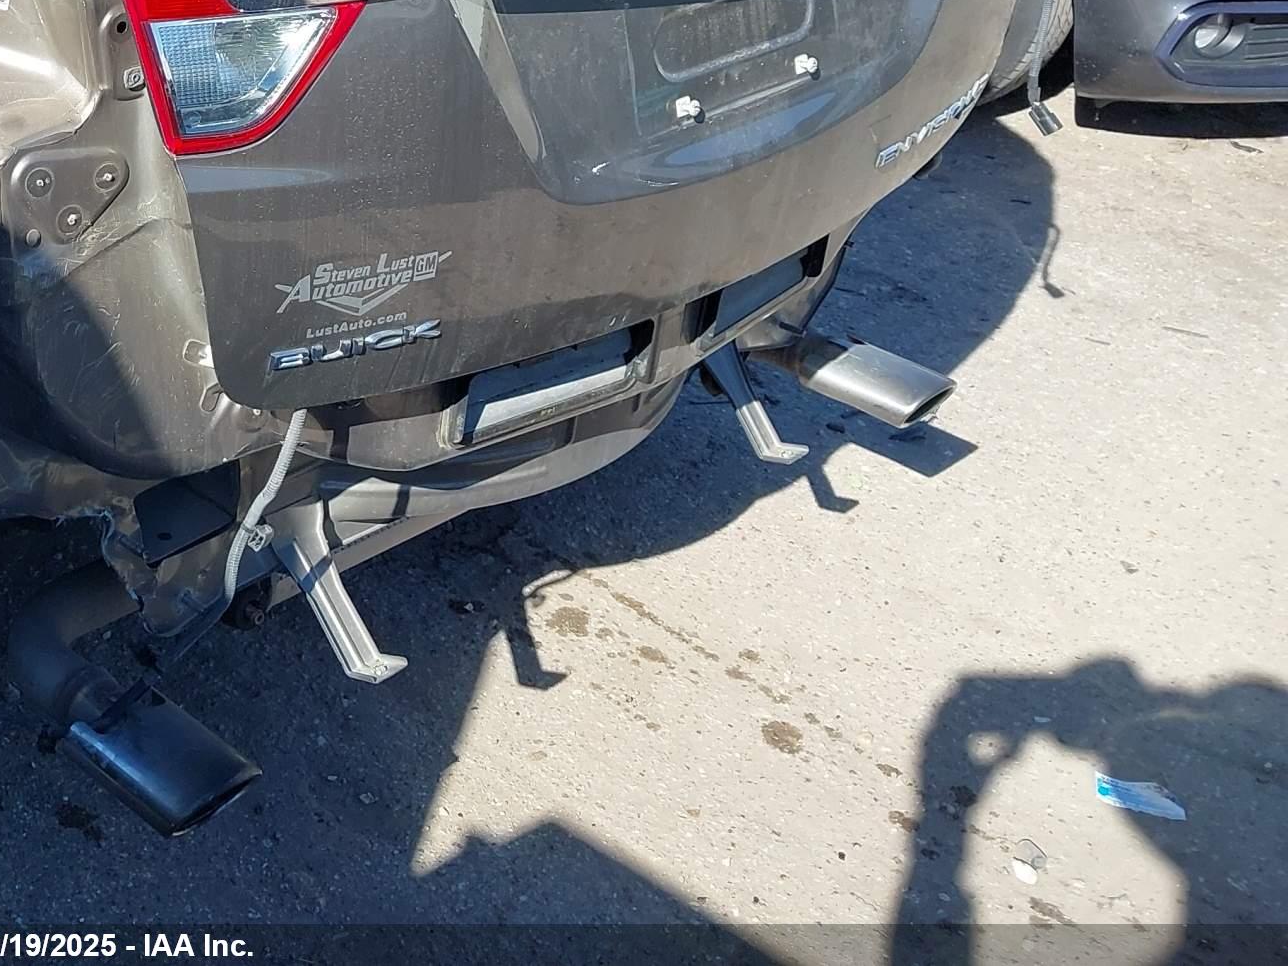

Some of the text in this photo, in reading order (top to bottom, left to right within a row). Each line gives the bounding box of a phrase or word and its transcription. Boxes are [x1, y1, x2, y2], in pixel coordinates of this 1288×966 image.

[313, 262, 372, 286] Steven
[376, 252, 415, 273] Lust
[275, 269, 413, 314] Automotive
[269, 318, 442, 371] BUICK
[305, 311, 408, 339] LustAuto.com
